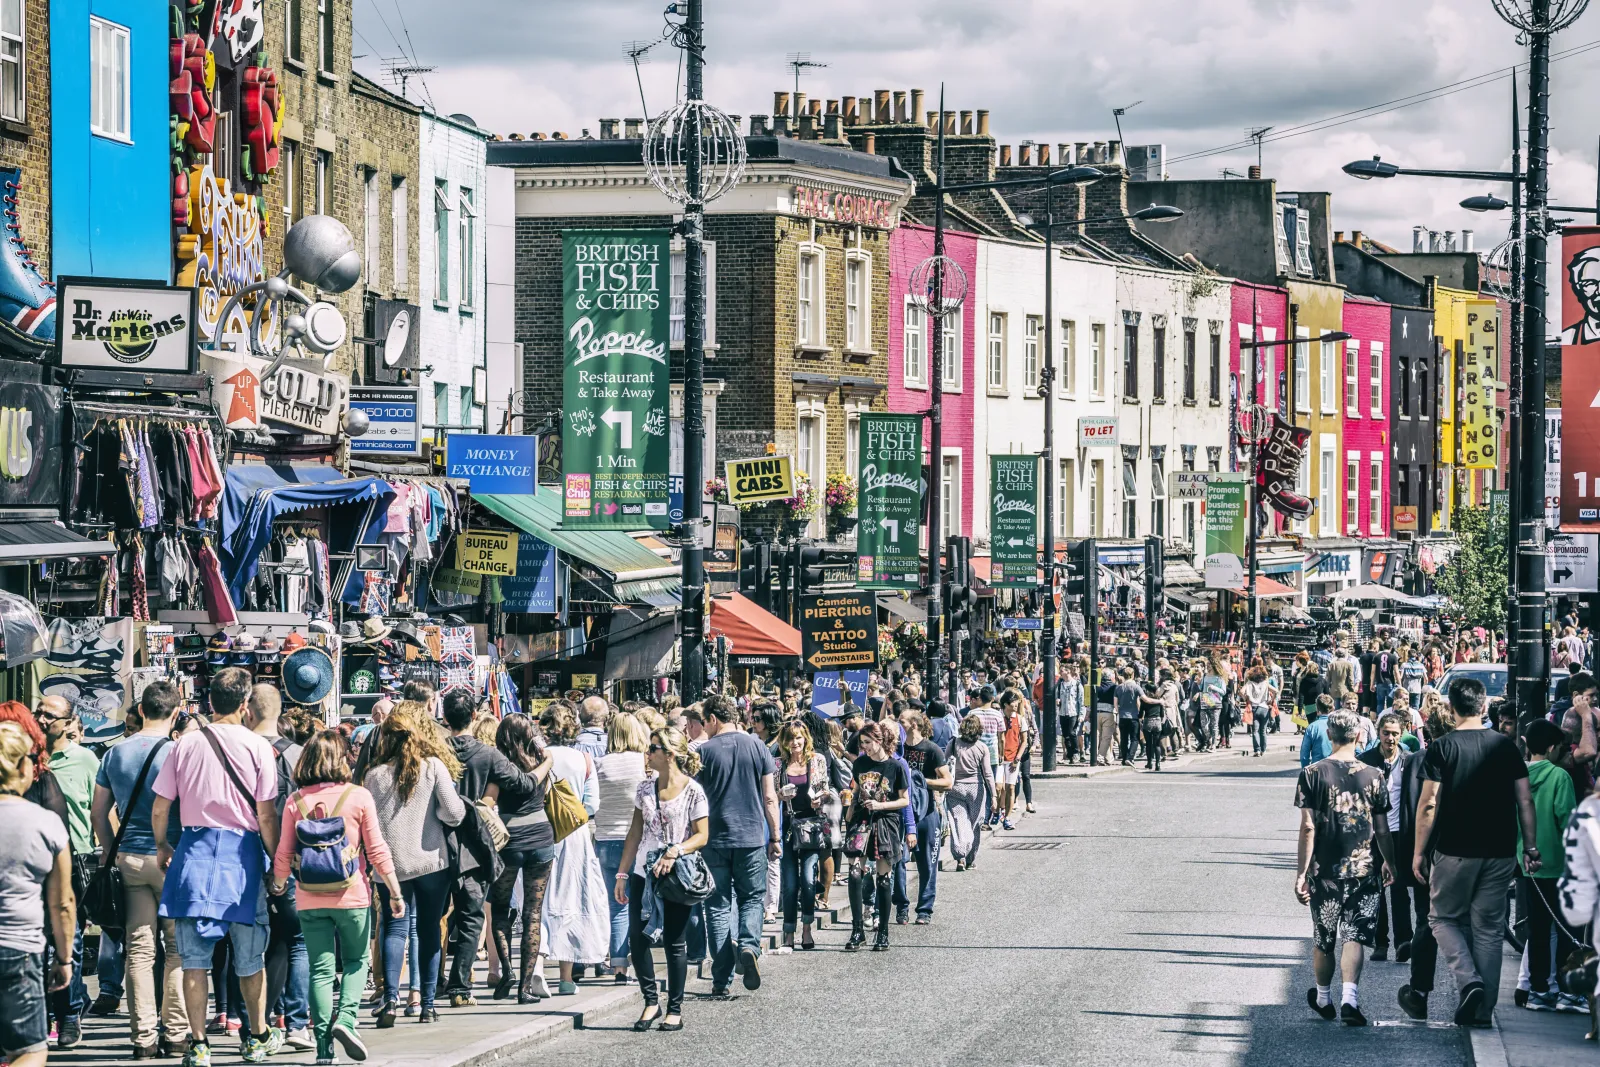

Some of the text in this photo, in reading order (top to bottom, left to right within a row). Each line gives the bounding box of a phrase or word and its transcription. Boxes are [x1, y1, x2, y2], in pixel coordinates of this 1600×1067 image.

[796, 186, 891, 228] TAKE COURAGE
[575, 244, 660, 262] BRITISH
[575, 262, 660, 292] FISH
[575, 293, 660, 310] & CHIPS
[73, 299, 102, 320] Dr.
[72, 314, 187, 342] Martens
[568, 315, 667, 360] Poppies
[238, 375, 252, 389] UP
[578, 370, 655, 384] Restaurant
[578, 387, 655, 402] & Take Away
[1466, 312, 1479, 465] PIERCING
[1481, 319, 1495, 458] & TATTOO
[262, 396, 323, 429] PIERCING
[384, 408, 413, 418] 1000
[645, 411, 667, 427] LIVE
[571, 418, 597, 437] Style
[867, 421, 916, 433] BRITISH
[1084, 425, 1114, 437] TO LET
[867, 432, 916, 450] FISH
[465, 448, 518, 461] MONEY
[867, 450, 916, 460] & CHIPS
[596, 455, 637, 468] 1 Min
[997, 461, 1033, 470] BRITISH
[451, 464, 531, 477] EXCHANGE
[736, 460, 781, 477] MINI
[862, 463, 918, 490] Poppies
[996, 469, 1034, 483] FISH
[1178, 474, 1209, 483] BLACK
[594, 480, 668, 490] FISH & CHIPS
[736, 475, 783, 492] CABS
[1208, 486, 1240, 494] Promote
[594, 490, 668, 499] RESTAURANT, UK
[867, 495, 911, 504] Restaurant
[1178, 489, 1206, 497] NAVY
[993, 493, 1036, 513] Poppies
[892, 506, 911, 514] Away
[466, 538, 508, 550] BUREAU
[877, 545, 900, 553] 1 Min
[479, 550, 493, 560] DE
[463, 560, 508, 573] CHANGE
[512, 590, 547, 598] BUREAU
[517, 600, 554, 608] CHANGE
[817, 598, 859, 607] Camden
[805, 606, 872, 618] PIERCING
[834, 619, 844, 628] &
[812, 629, 867, 642] TATTOO
[823, 642, 857, 651] Studio
[815, 654, 871, 663] DOWNSTAIRS
[1380, 653, 1388, 672] 8
